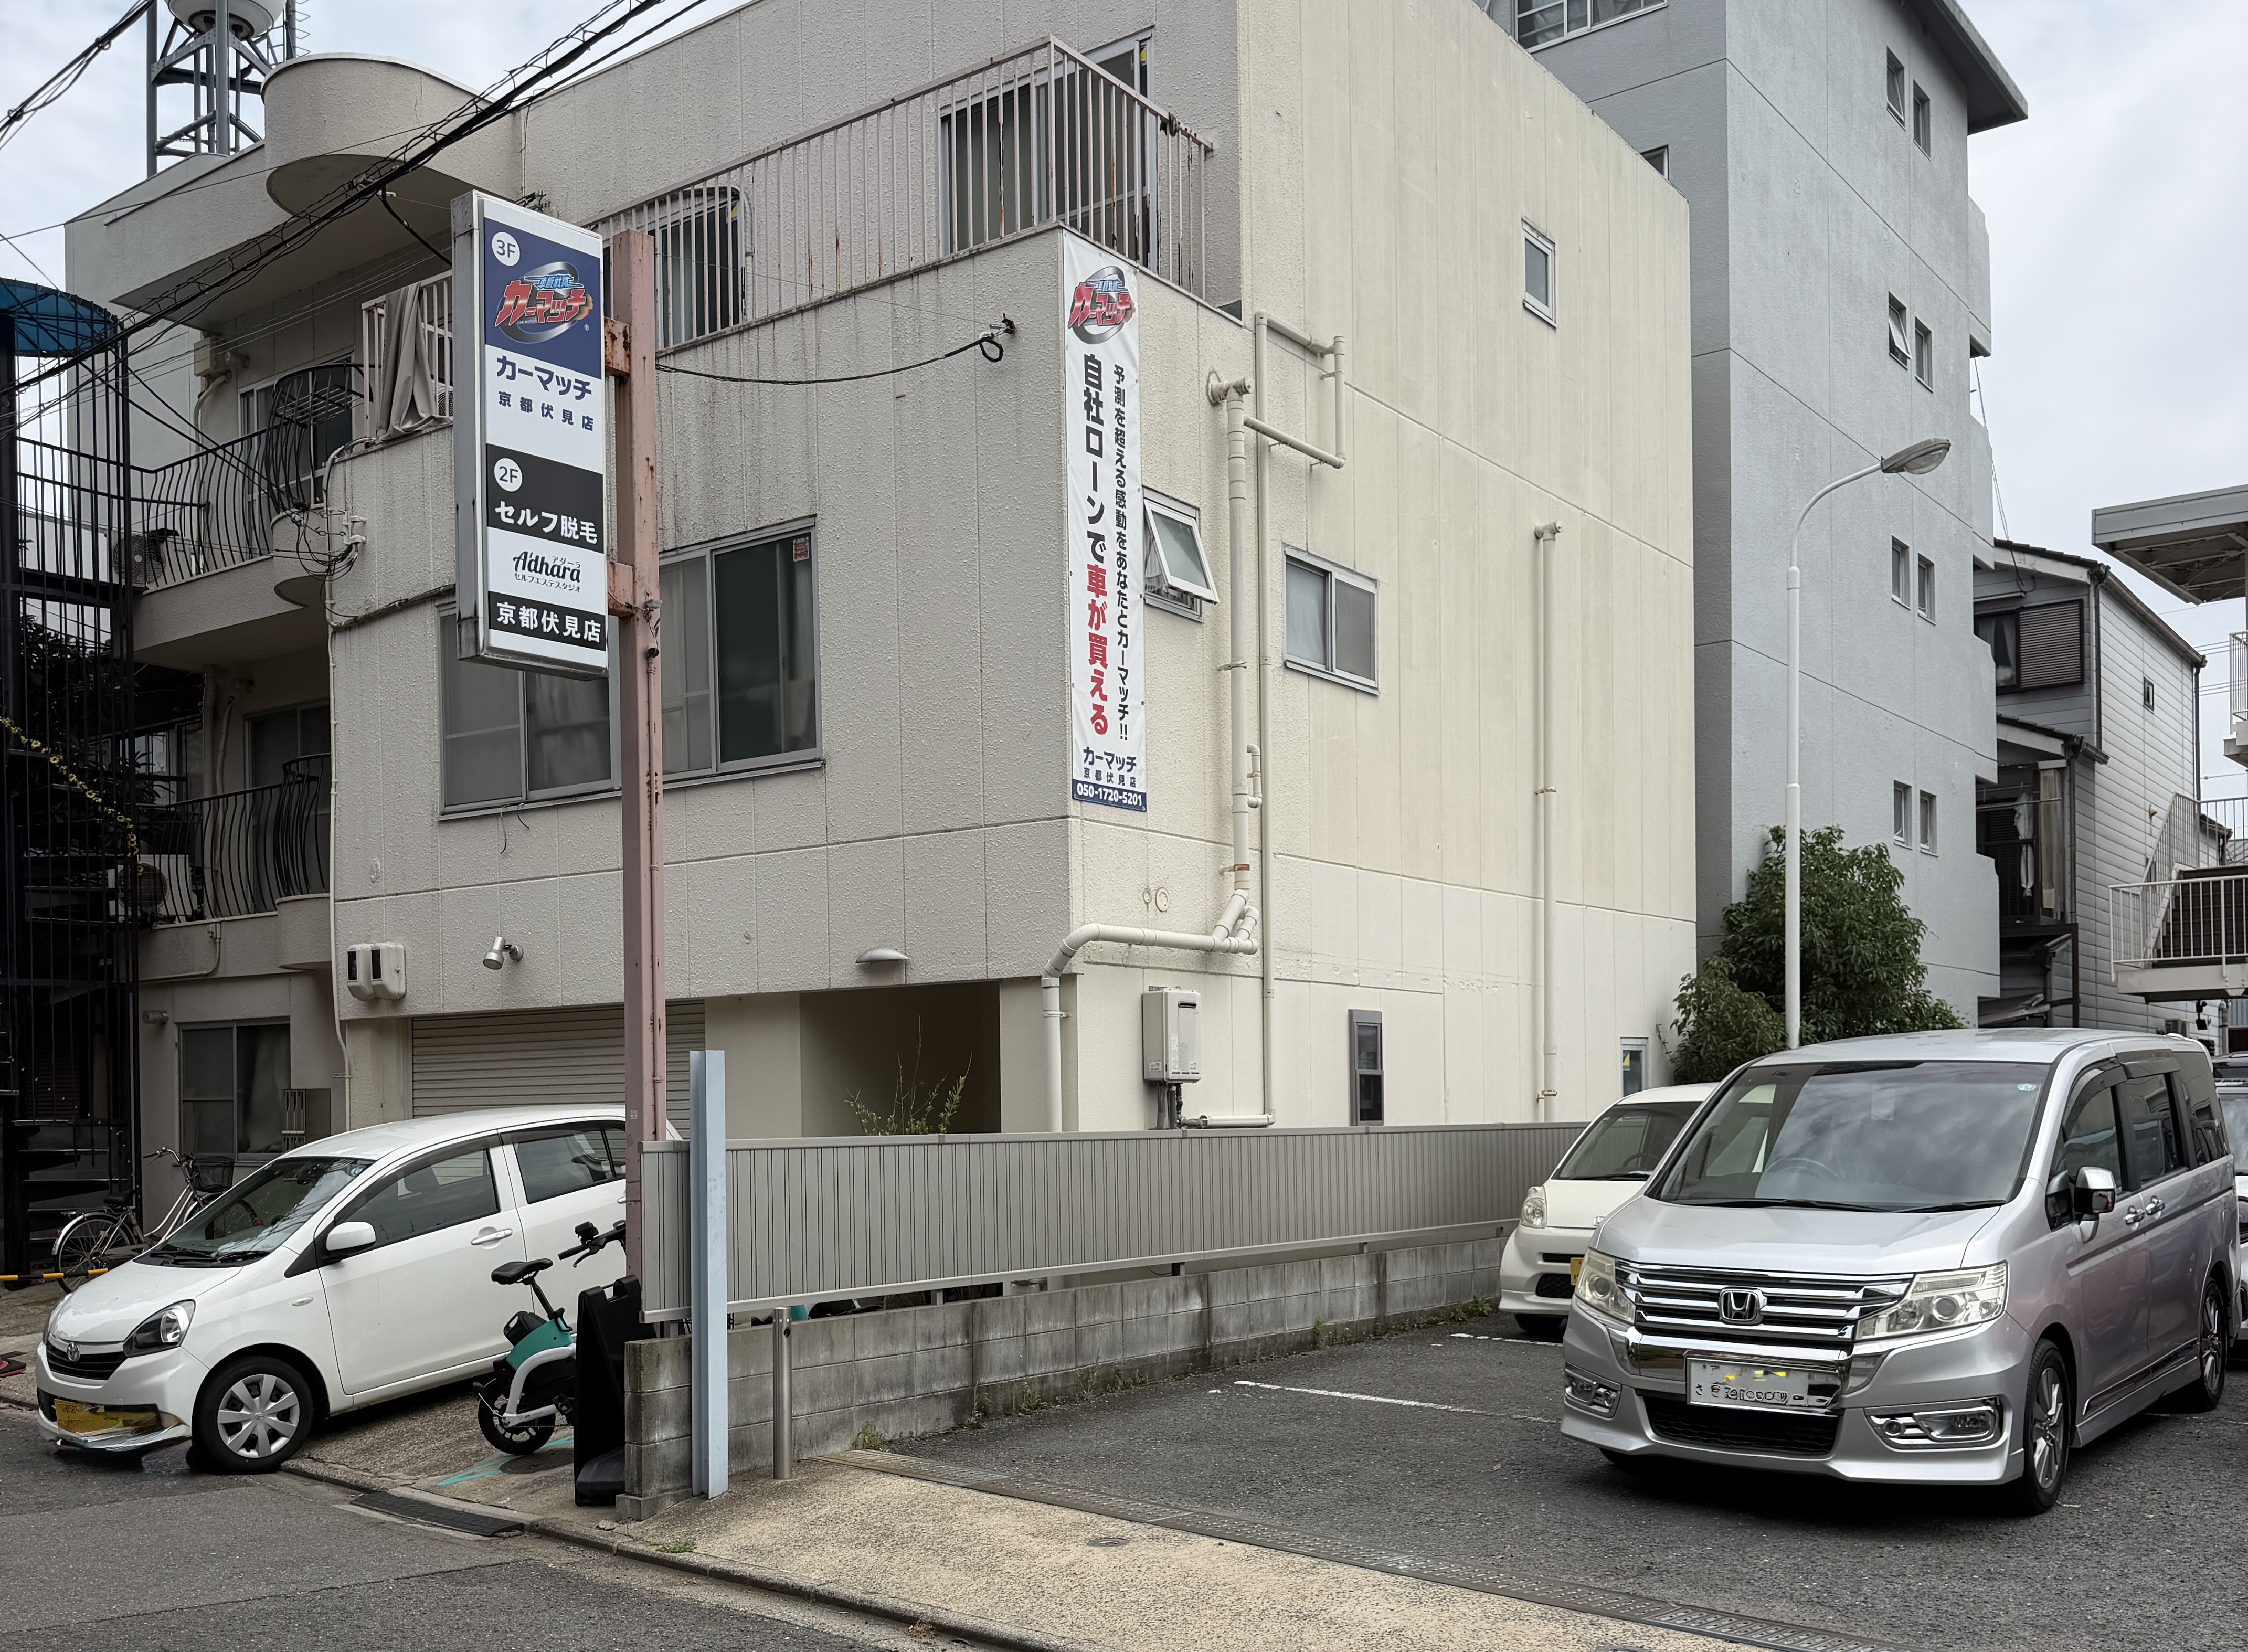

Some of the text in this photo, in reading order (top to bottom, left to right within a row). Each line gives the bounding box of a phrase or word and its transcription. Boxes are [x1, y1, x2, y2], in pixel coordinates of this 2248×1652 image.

[496, 239, 516, 259] 3F
[494, 280, 586, 327] カーマッチ
[1068, 282, 1131, 329] カーマッチ
[497, 355, 592, 400] カーマッチ
[499, 391, 593, 431] 京都伏見店
[499, 466, 518, 483] 2F
[495, 501, 597, 544] セルフ脱毛
[552, 556, 581, 568] アダーラ
[1084, 354, 1108, 735] 自社ローンで車が買える
[514, 572, 580, 593] セルフエステスタジオ
[496, 602, 601, 643] 京都伏見店
[1083, 746, 1137, 772] カーマッチ
[1077, 783, 1142, 806] 050-1720-5201
